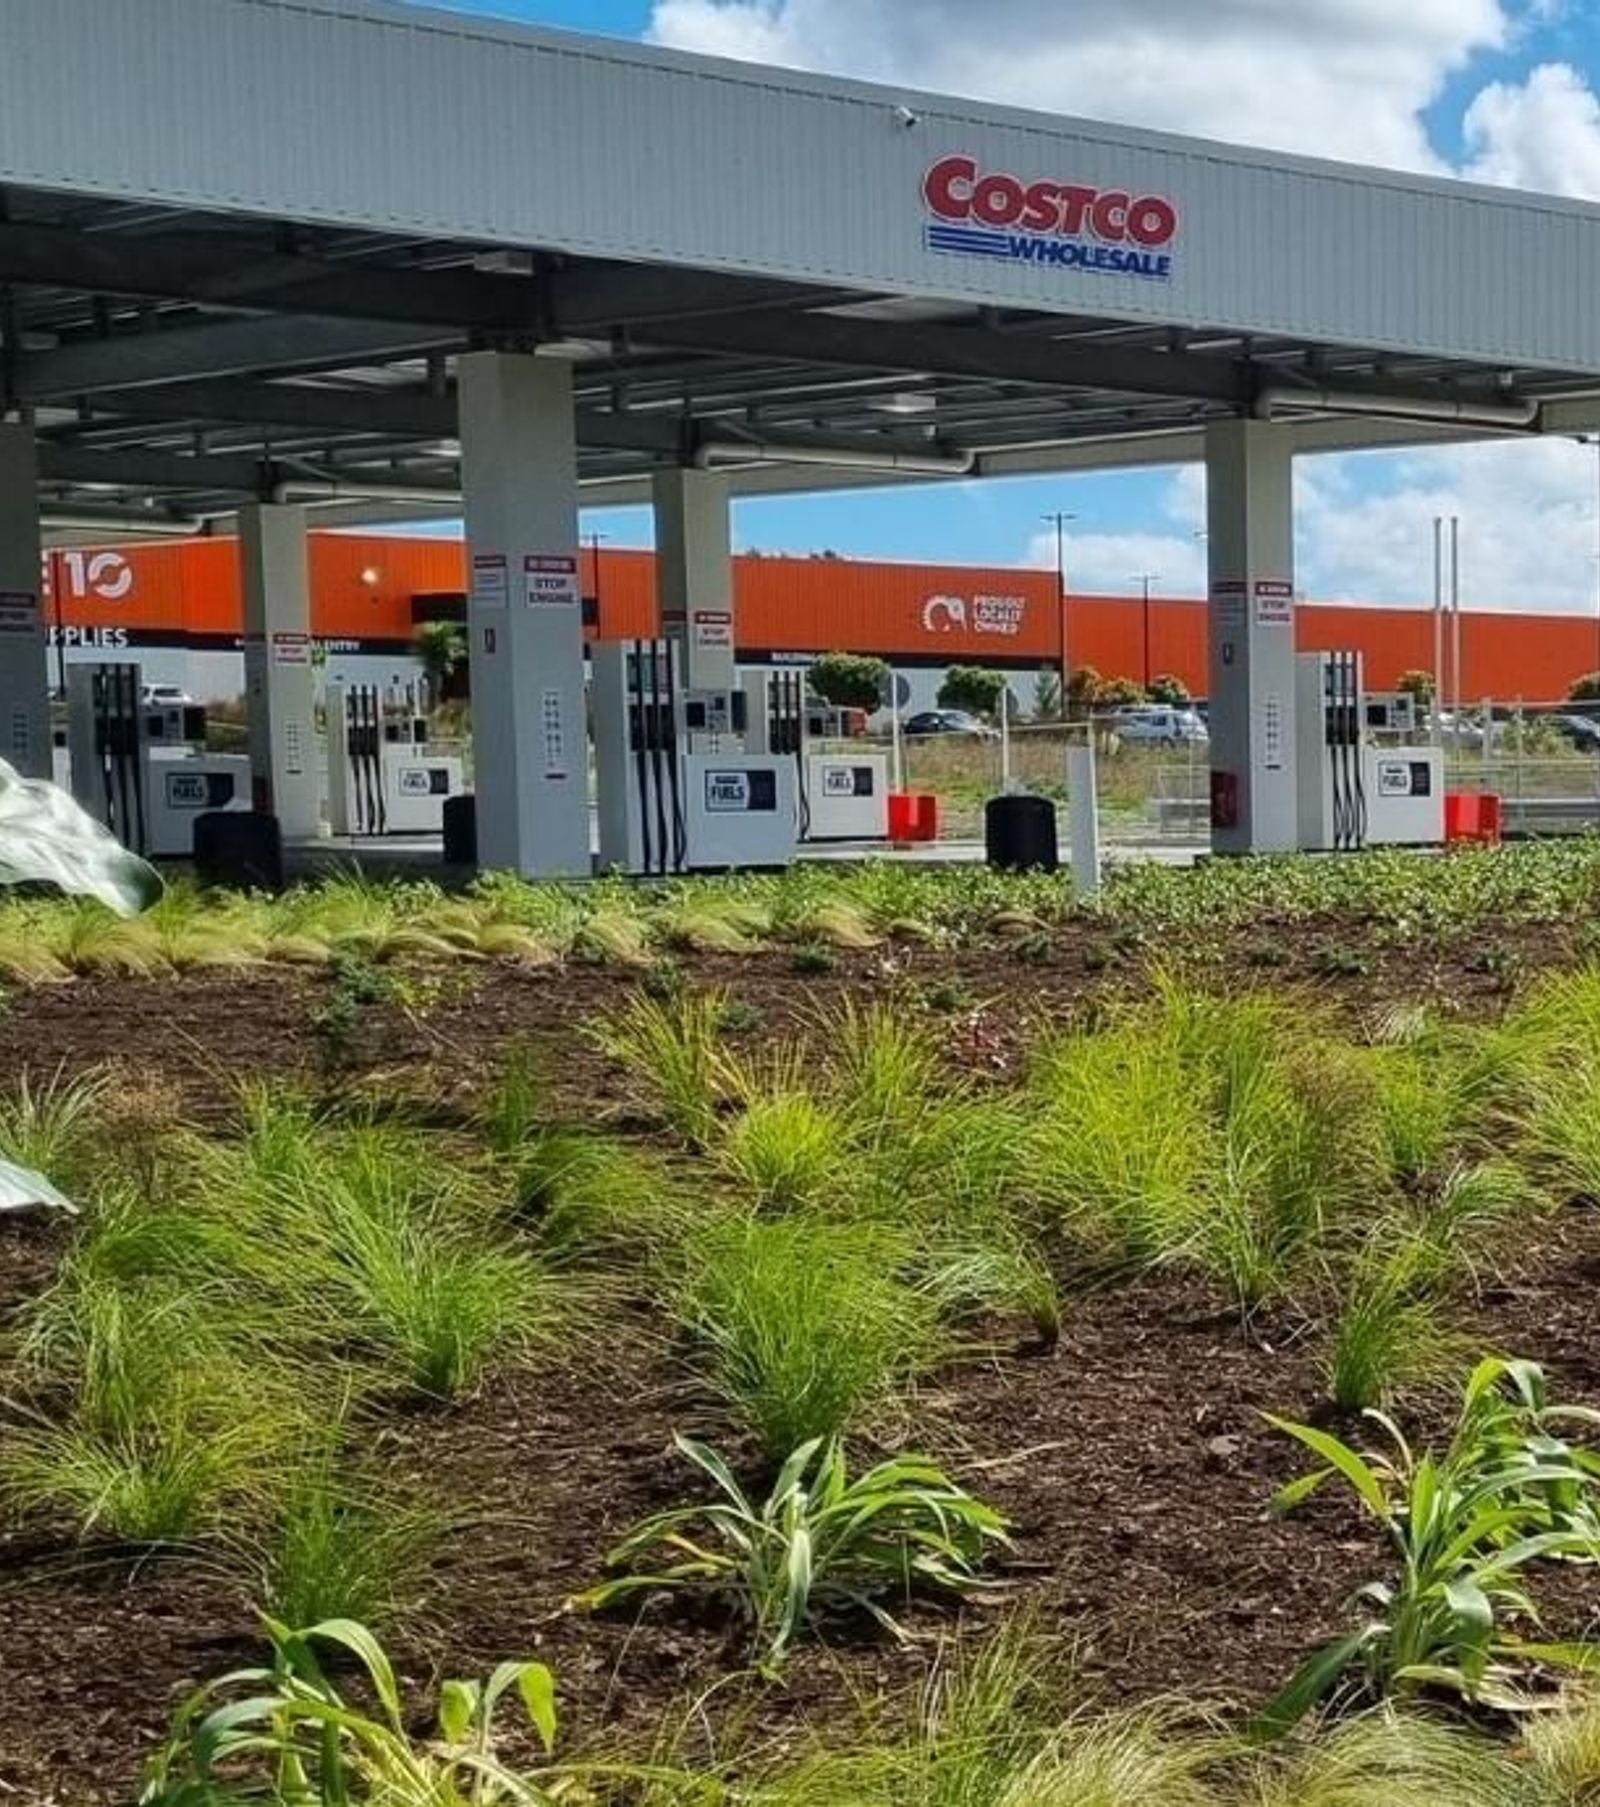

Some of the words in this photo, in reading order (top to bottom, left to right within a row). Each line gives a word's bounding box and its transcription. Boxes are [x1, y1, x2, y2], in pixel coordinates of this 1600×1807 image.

[924, 155, 1177, 247] COSTCO
[1006, 235, 1171, 278] WHOLESALE
[48, 626, 129, 648] PPLIES
[710, 786, 746, 801] FUELS
